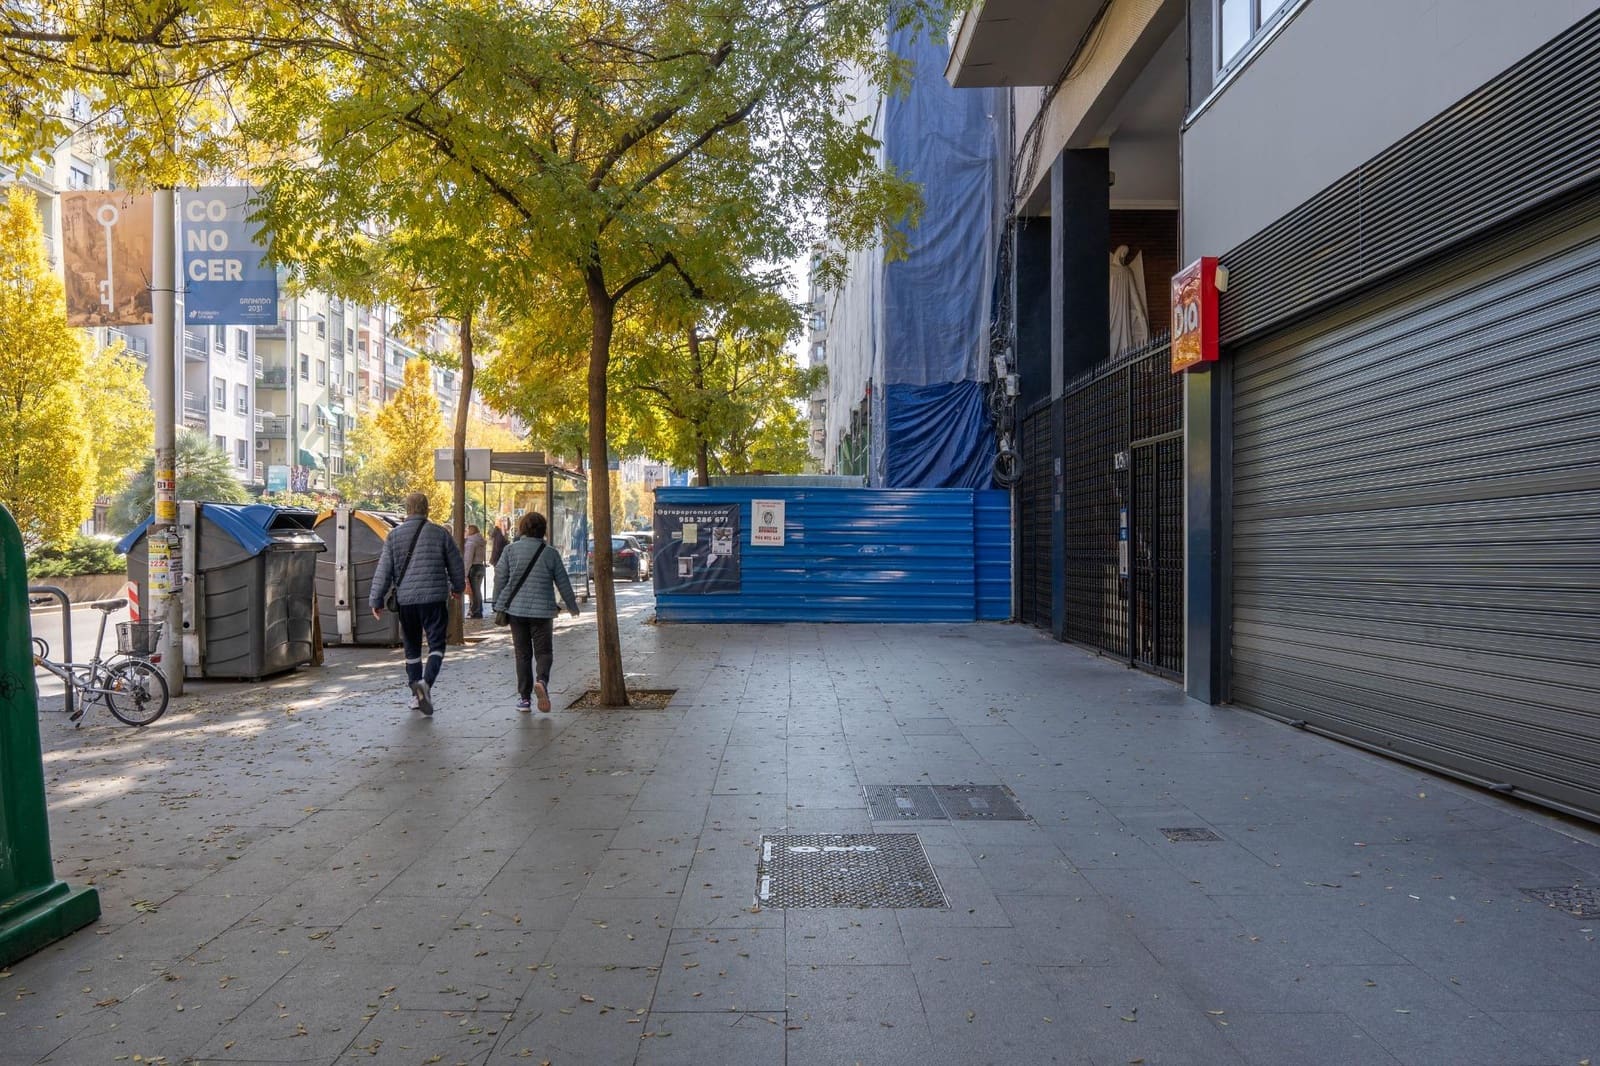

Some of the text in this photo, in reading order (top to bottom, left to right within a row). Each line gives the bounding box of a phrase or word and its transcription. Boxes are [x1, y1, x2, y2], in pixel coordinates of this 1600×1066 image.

[186, 199, 227, 223] CO
[187, 229, 229, 252] NO
[188, 258, 243, 282] CER
[247, 305, 263, 313] 2031
